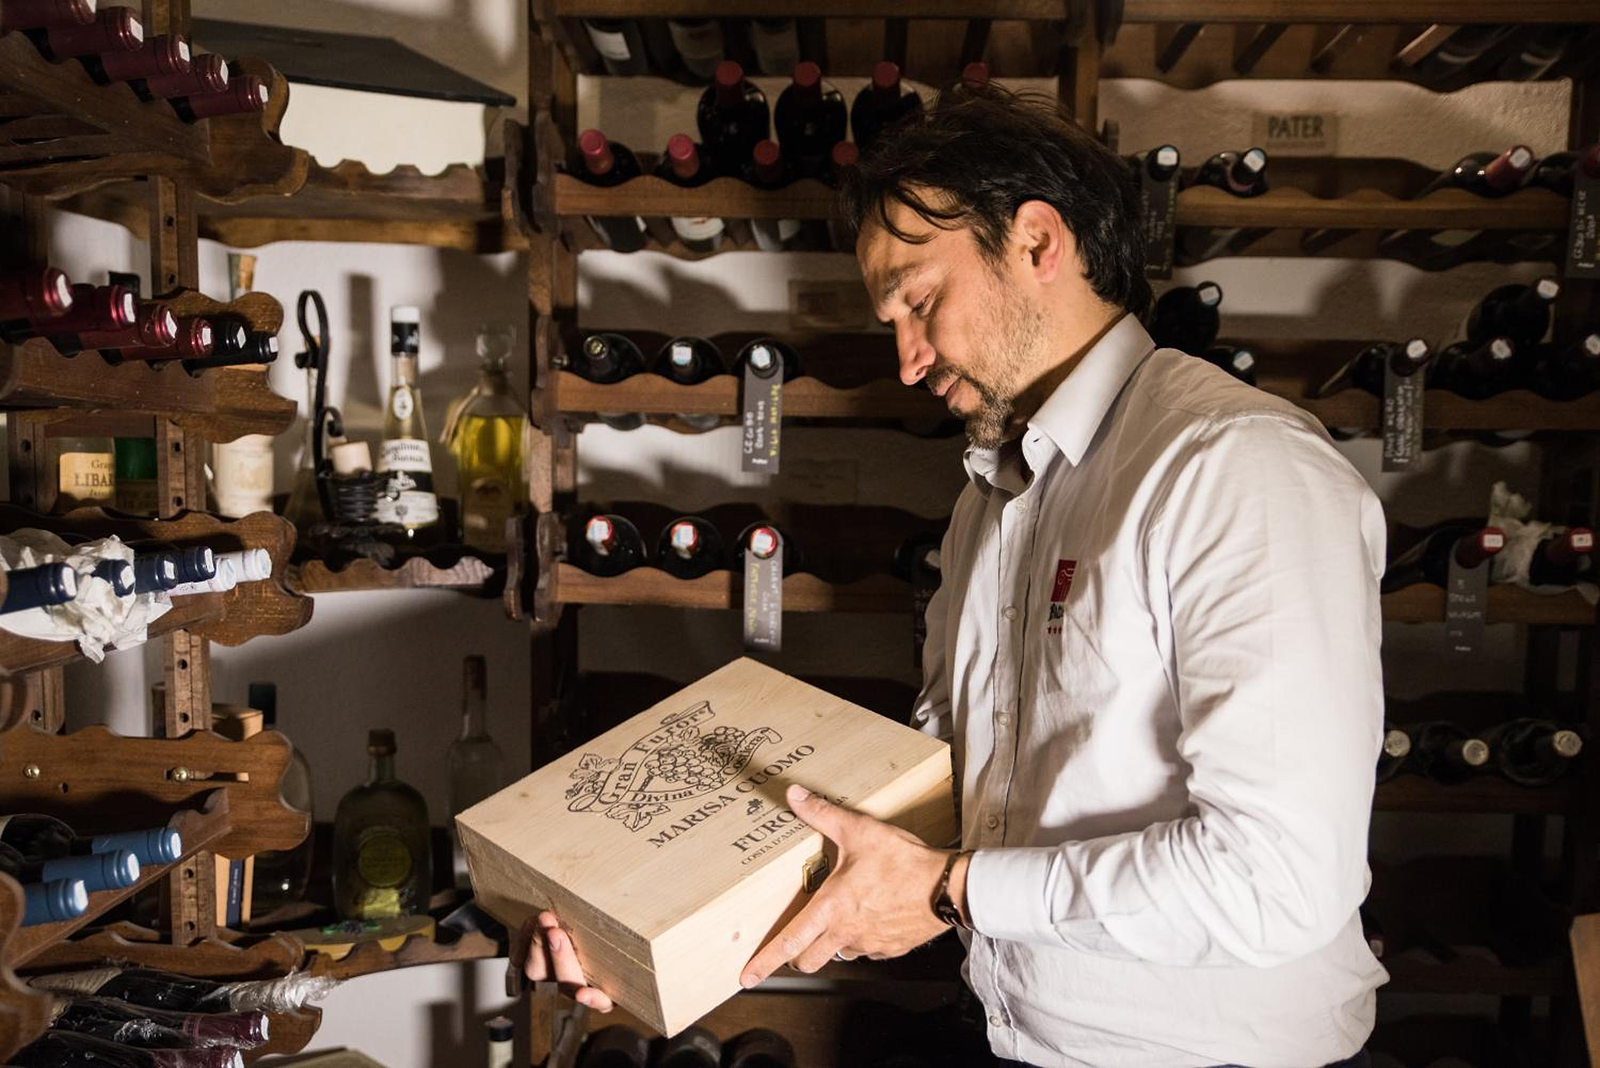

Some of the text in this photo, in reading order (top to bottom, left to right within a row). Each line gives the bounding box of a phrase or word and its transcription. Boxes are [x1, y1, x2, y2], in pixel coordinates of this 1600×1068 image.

[1267, 115, 1324, 138] PATER
[598, 761, 639, 805] Gran
[631, 790, 694, 802] Divina
[646, 743, 816, 849] MARISA CUOMO
[731, 809, 799, 853] FURO
[741, 822, 809, 866] COSTA D'AMAL
